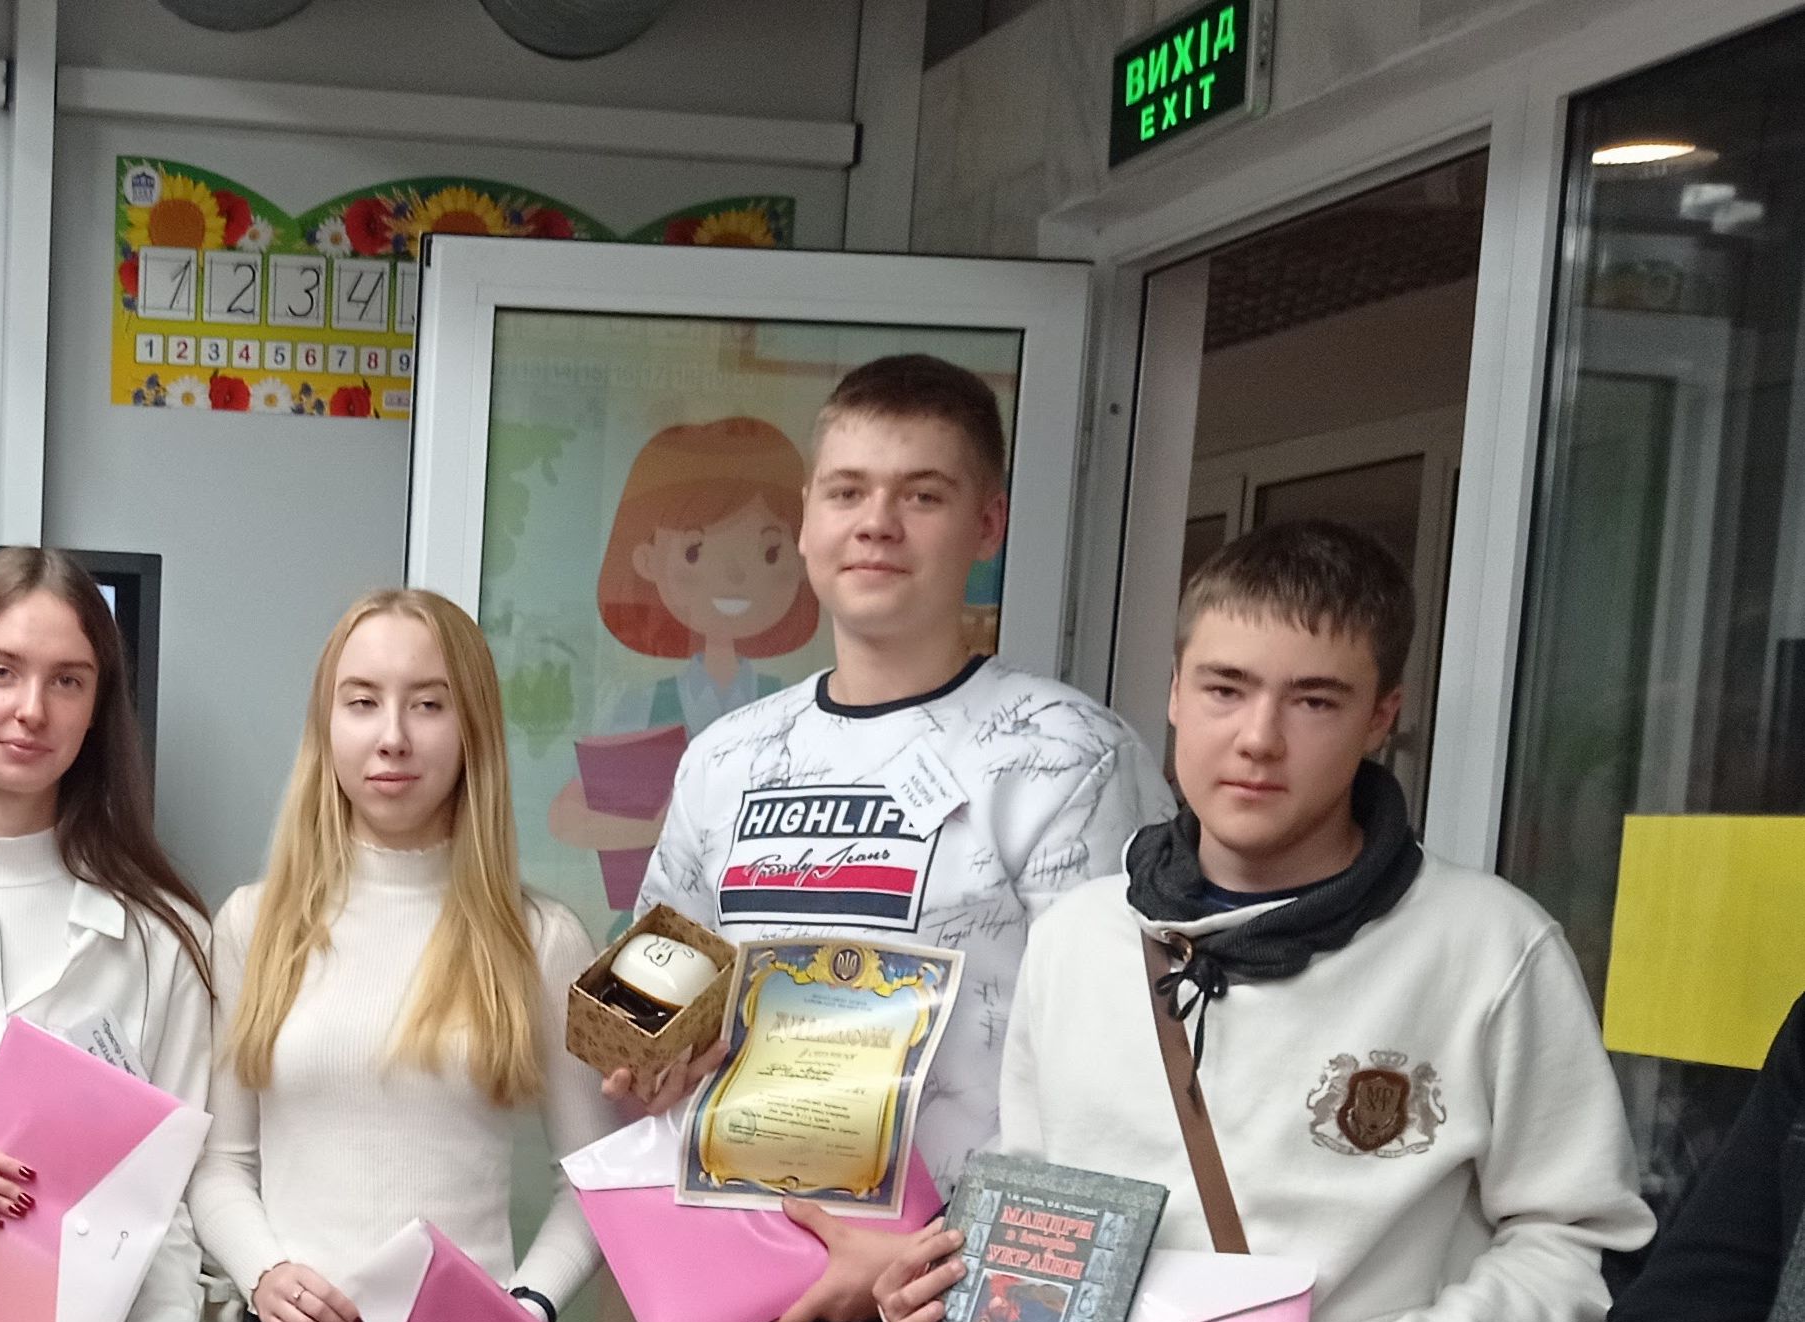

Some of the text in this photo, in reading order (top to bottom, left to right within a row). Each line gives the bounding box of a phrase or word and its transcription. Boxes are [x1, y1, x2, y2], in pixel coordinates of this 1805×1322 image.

[1126, 5, 1235, 107] ВИХІД
[1140, 72, 1216, 142] EXIT
[227, 263, 256, 314] 2
[287, 267, 321, 317] 3
[347, 271, 385, 321] 4
[145, 340, 411, 370] 1 2 3 4 5 6 7 8 9
